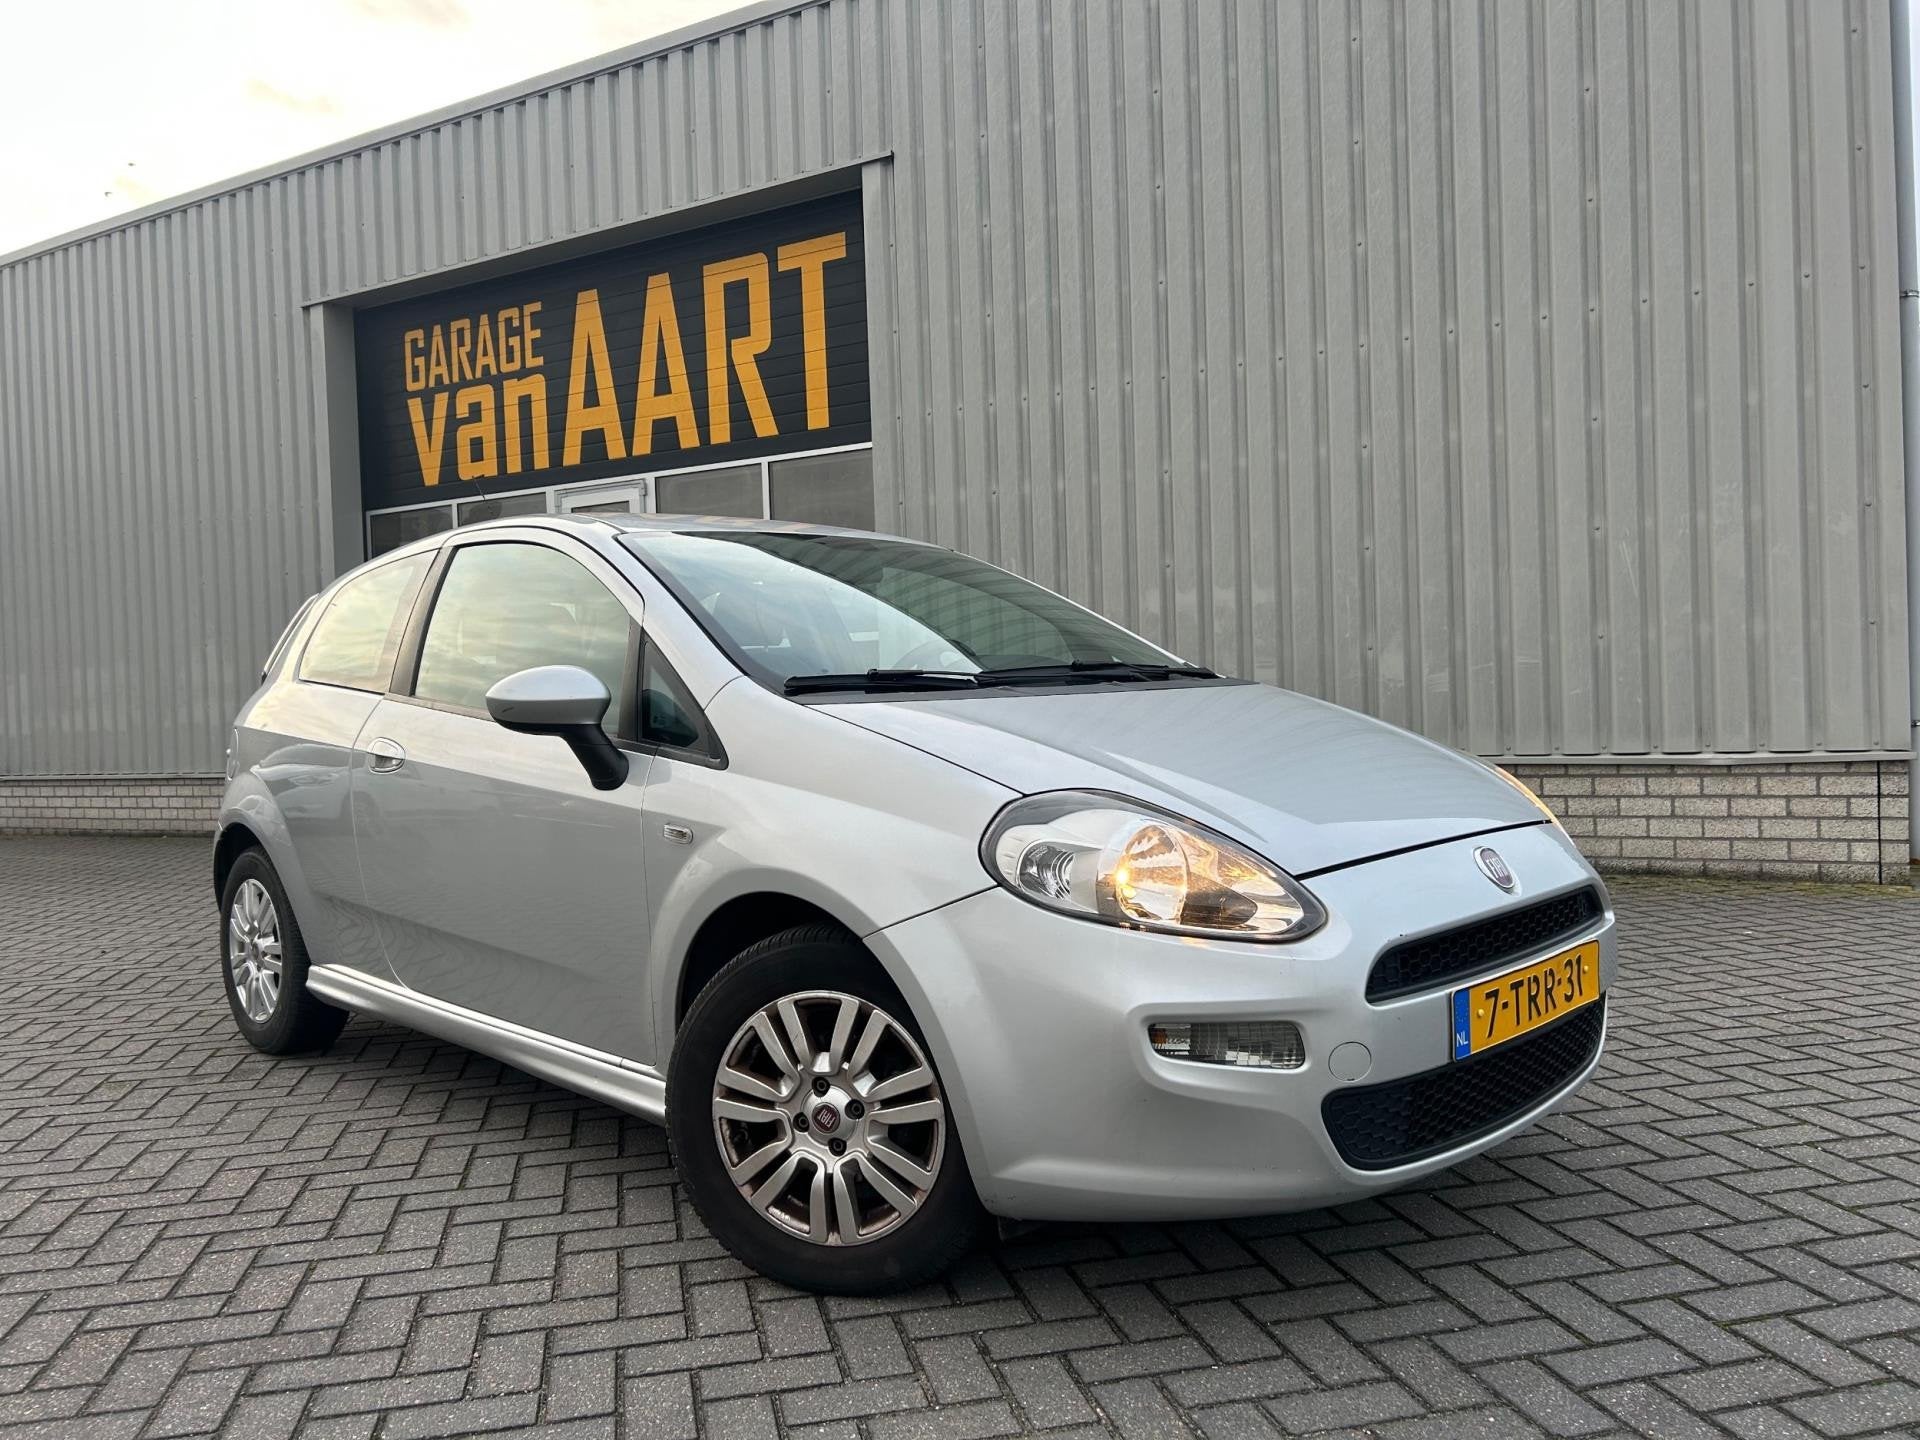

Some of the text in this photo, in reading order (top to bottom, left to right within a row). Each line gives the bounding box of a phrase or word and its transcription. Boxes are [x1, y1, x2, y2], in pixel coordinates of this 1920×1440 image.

[404, 301, 545, 393] GARAGE
[407, 231, 847, 487] van AART
[1485, 857, 1507, 879] FIAT
[1484, 954, 1583, 1039] 7-TRR-31
[1456, 1031, 1469, 1047] NL
[816, 1109, 836, 1128] FIAT
